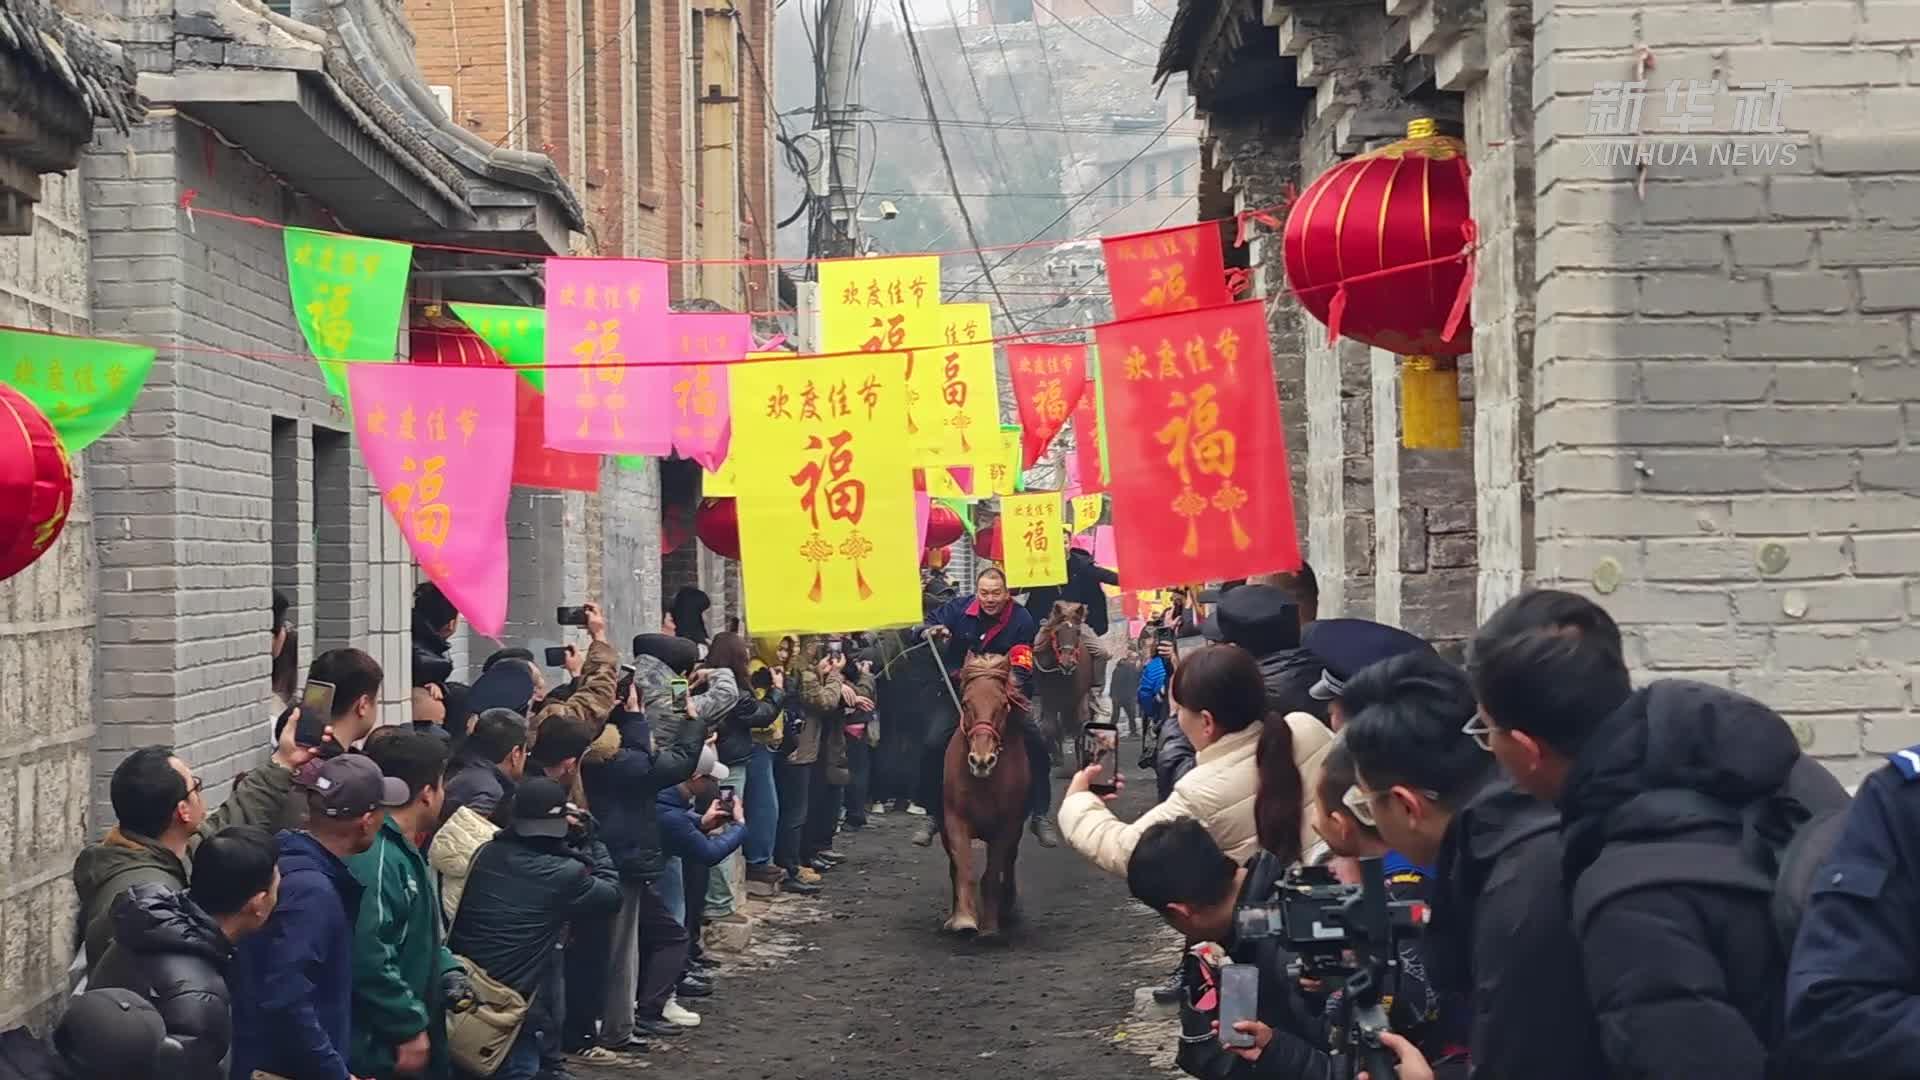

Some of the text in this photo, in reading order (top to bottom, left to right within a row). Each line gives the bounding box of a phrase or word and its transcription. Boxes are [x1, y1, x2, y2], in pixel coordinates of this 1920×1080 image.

[843, 275, 928, 309] 欢度佳节
[307, 282, 353, 353] 福
[944, 320, 978, 344] 佳节
[572, 319, 626, 388] 福
[1020, 354, 1073, 377] 欢度佳节
[1123, 328, 1241, 381] 欢度佳节
[766, 374, 883, 422] 欢度佳节
[1032, 378, 1068, 422] 福
[366, 404, 480, 447] 欢度佳节
[1153, 383, 1237, 485] 福
[385, 456, 451, 547] 福
[790, 430, 866, 530] 福
[1023, 520, 1049, 552] 福
